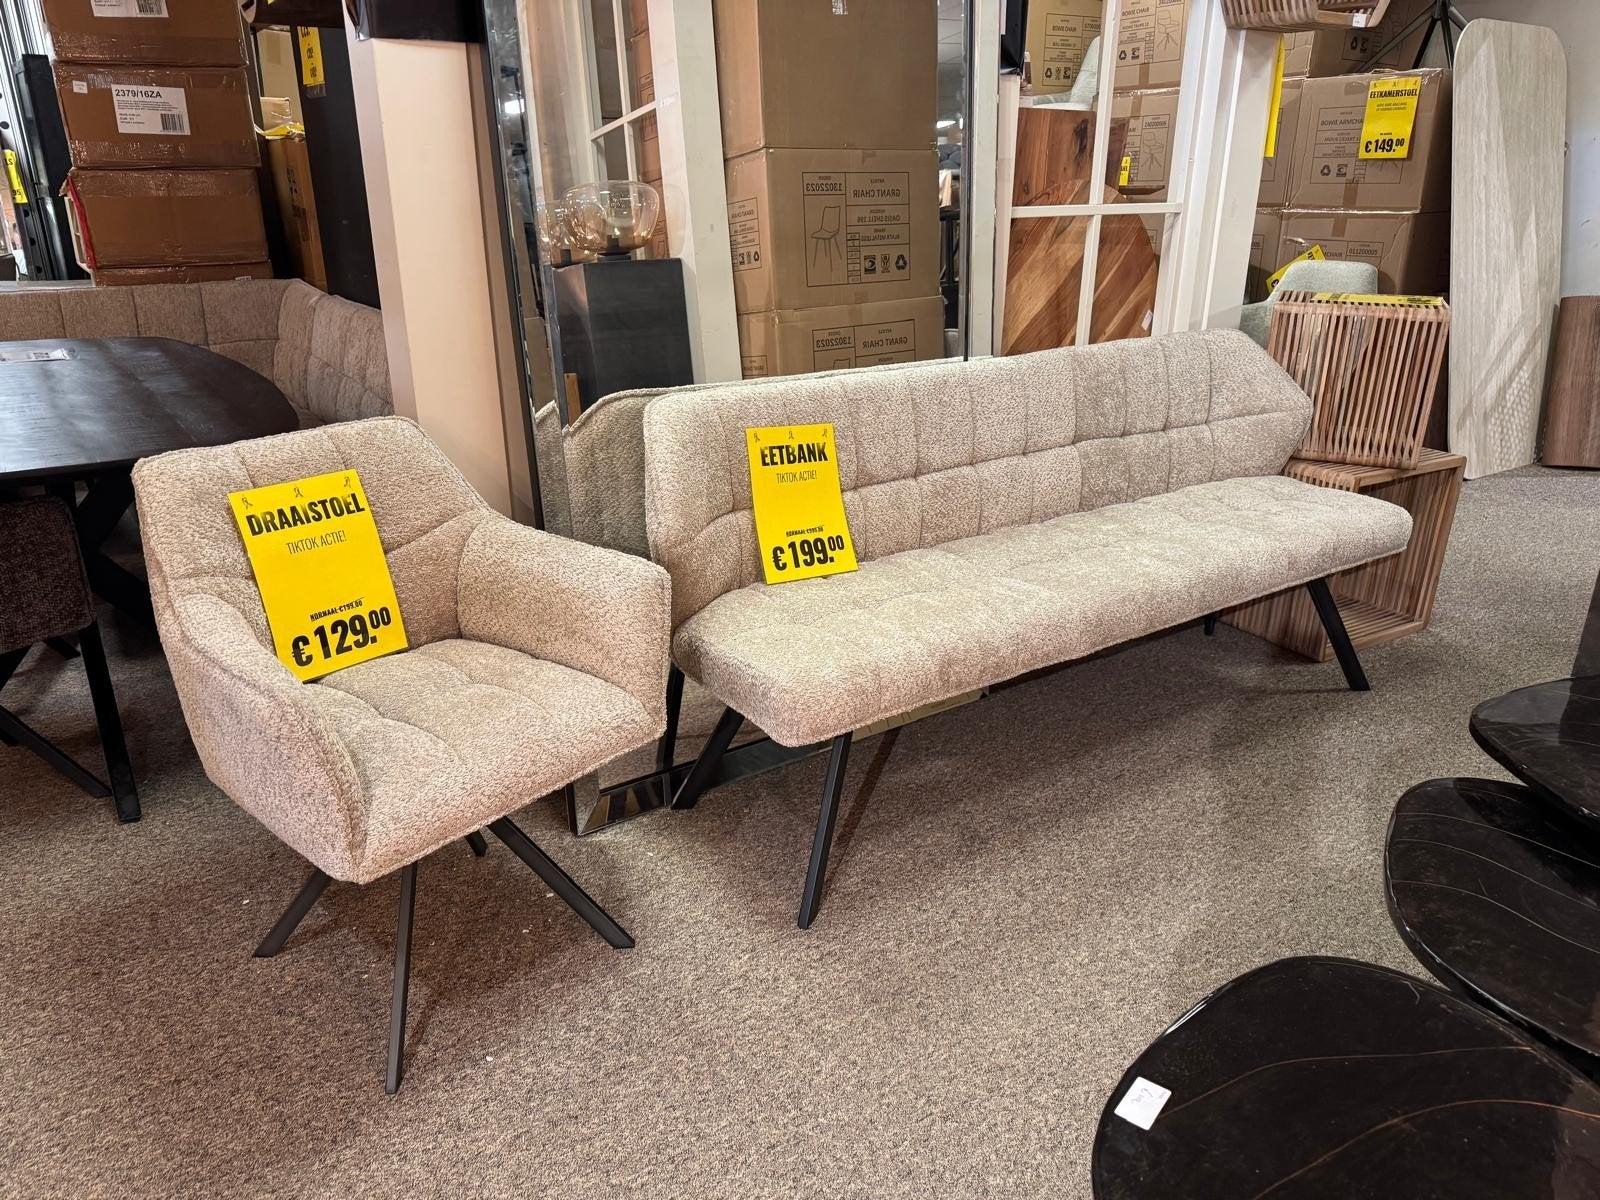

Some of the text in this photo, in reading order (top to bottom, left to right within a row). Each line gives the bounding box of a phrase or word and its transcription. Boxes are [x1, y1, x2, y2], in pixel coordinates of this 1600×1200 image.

[114, 88, 162, 98] 2379/16ZA
[1370, 88, 1418, 98] EETKAMERSTOEL
[1338, 118, 1363, 126] ARMCHA
[760, 442, 828, 467] EETBANK
[776, 470, 817, 484] TIKTOK ACTIE!
[245, 492, 365, 537] DRAAISTOEL
[286, 530, 346, 556] TIKTOK ACTIE!
[310, 606, 338, 622] NORMAAL
